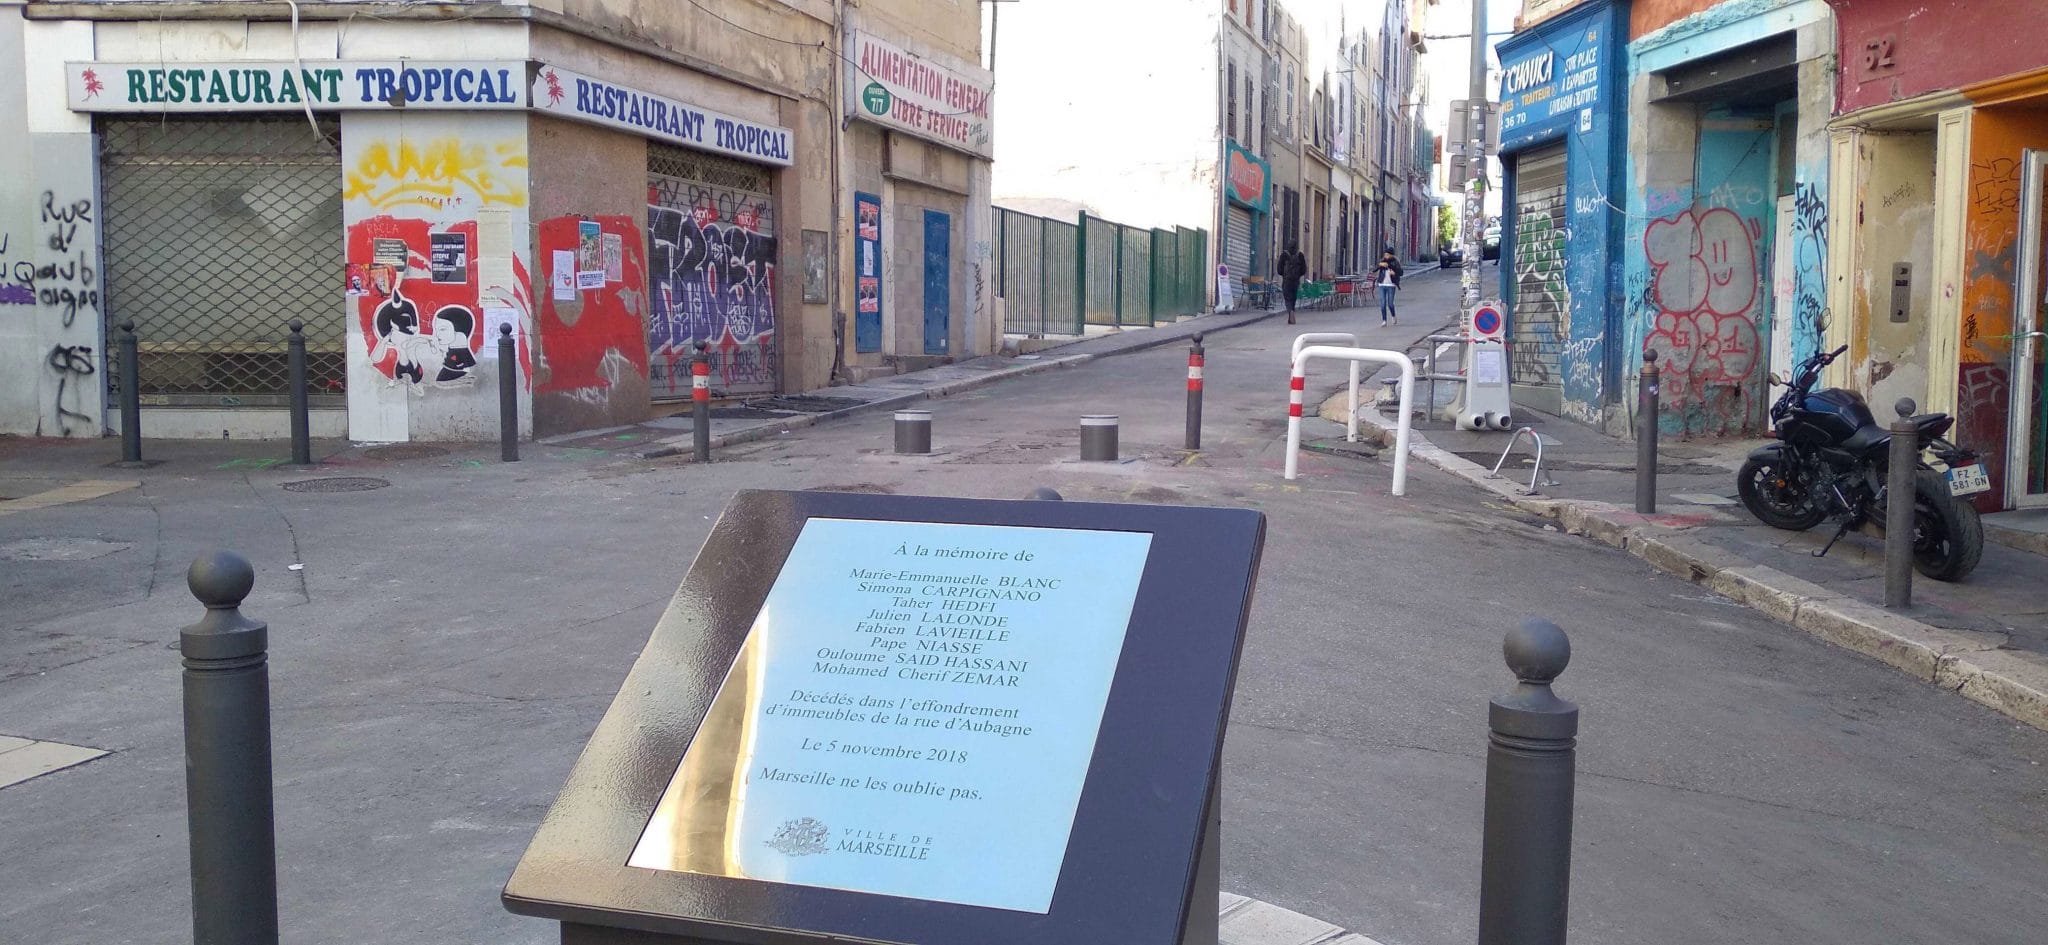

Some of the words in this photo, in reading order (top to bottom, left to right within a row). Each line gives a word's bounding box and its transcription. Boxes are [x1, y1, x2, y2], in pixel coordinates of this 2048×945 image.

[1577, 46, 1598, 68] PLACE
[126, 68, 344, 104] RESTAURANT
[355, 67, 517, 104] TROPICAL
[861, 41, 943, 102] ALIMENTATION
[945, 76, 988, 119] GENERAL
[870, 97, 884, 113] 7/7
[575, 78, 705, 143] RESTAURANT
[714, 118, 789, 161] TROPICAL
[891, 96, 923, 127] LIBRE
[926, 109, 969, 143] SERVICE
[1516, 112, 1527, 123] 70
[41, 190, 92, 223] Rue
[1952, 477, 1987, 490] 581-GN
[1957, 470, 1969, 479] FZ
[894, 542, 907, 555] À
[914, 545, 928, 556] la
[934, 547, 1008, 560] mémoire
[1014, 550, 1034, 561] de
[849, 569, 988, 587] Marie-Emmanuelle
[999, 577, 1061, 589] BLANC
[858, 582, 911, 594] Simona
[922, 584, 1041, 601] CARPIGNANO
[893, 597, 933, 608] Taher
[941, 600, 996, 612] HEDFI
[867, 609, 911, 621] Julien
[922, 612, 1008, 627] LALONDE
[855, 622, 905, 634] Fabien
[916, 625, 1010, 641] LAVIEILLE
[871, 637, 906, 651] Pape
[916, 640, 983, 654] NIASSE
[817, 648, 885, 662] Ouloume
[895, 653, 939, 665] SAID
[944, 656, 1029, 672] HASSANI
[813, 662, 889, 677] Mohamed
[899, 668, 951, 681] Cherif
[952, 672, 1018, 687] ZEMAR
[790, 690, 854, 705] Décédés
[859, 695, 894, 708] dans
[900, 698, 1018, 718] l'effondrement
[766, 703, 865, 722] d'immeubles
[871, 712, 889, 723] de
[895, 713, 908, 725] la
[913, 718, 939, 727] rue
[945, 717, 1032, 737] d'Aubagne
[801, 738, 822, 750] Le
[826, 740, 838, 751] 5
[841, 745, 921, 759] novembre
[926, 749, 967, 763] 2018
[759, 768, 835, 785] Marseille
[840, 778, 859, 787] ne
[864, 777, 887, 790] les
[893, 781, 945, 796] oublie
[949, 788, 982, 800] pas.
[846, 829, 897, 841] VILLE
[911, 836, 932, 844] DE
[836, 839, 932, 860] MARSEILLE
